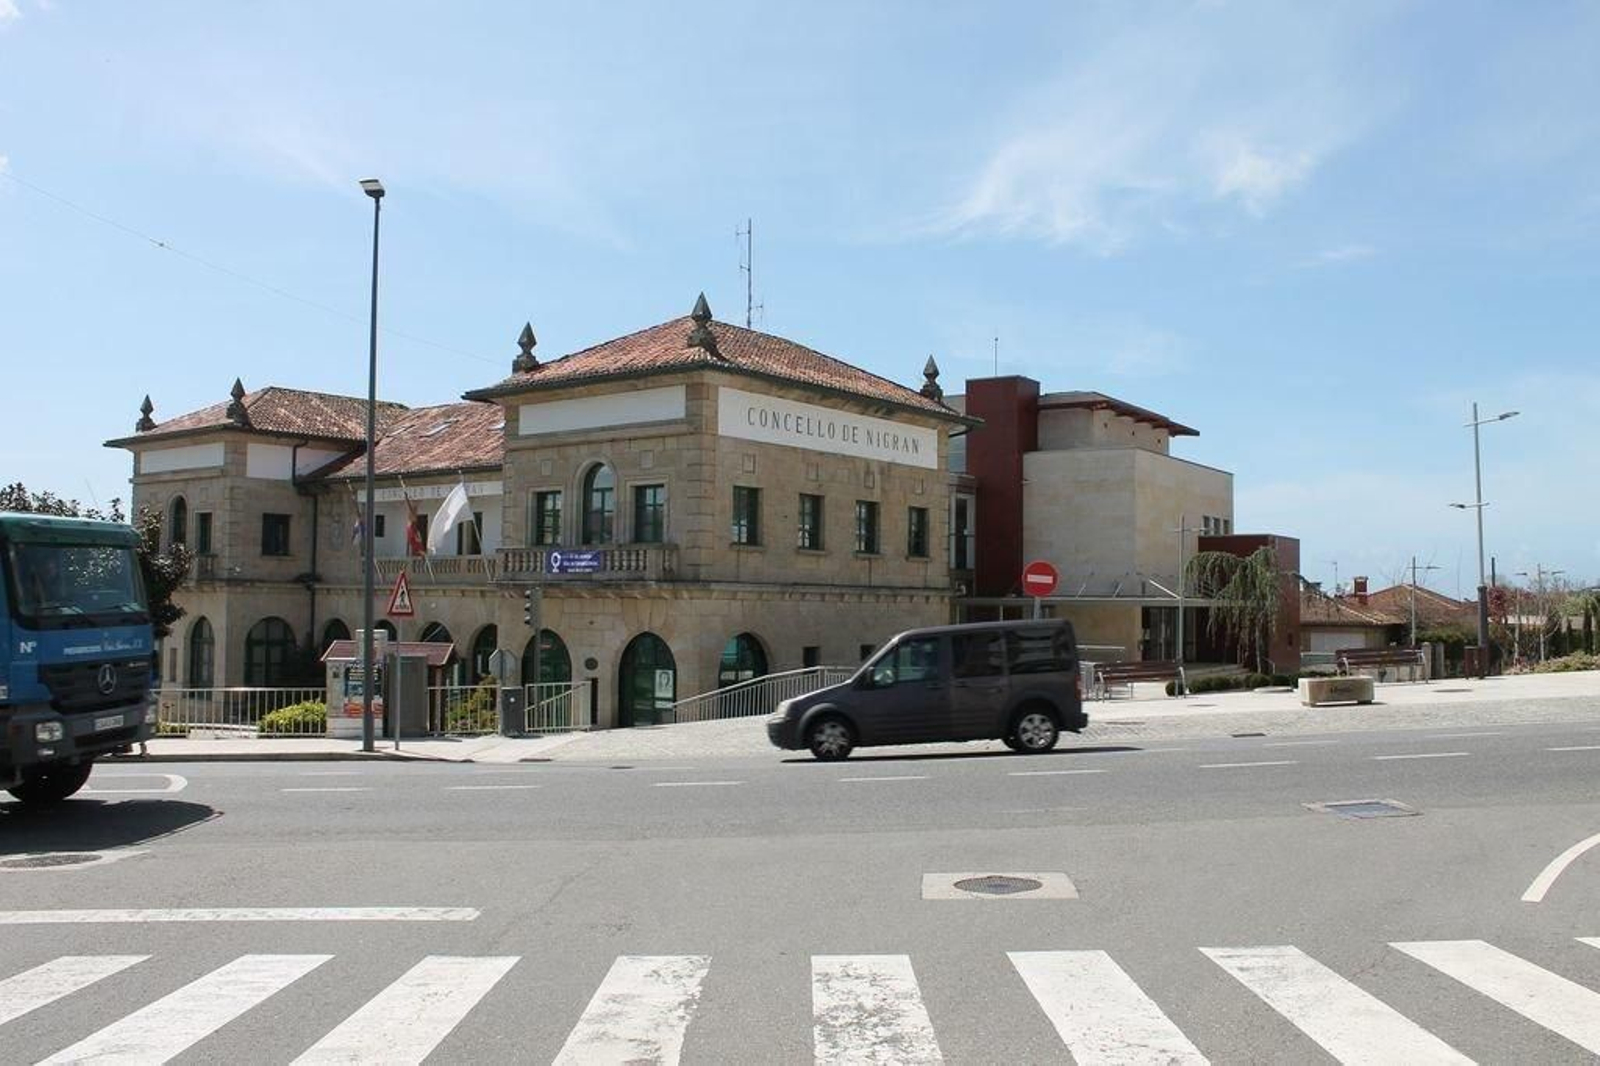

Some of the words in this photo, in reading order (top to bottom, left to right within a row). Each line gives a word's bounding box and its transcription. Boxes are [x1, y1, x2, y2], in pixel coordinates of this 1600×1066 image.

[747, 407, 835, 439] CONCELLO
[842, 424, 859, 443] DE
[866, 429, 919, 454] NIGRAN
